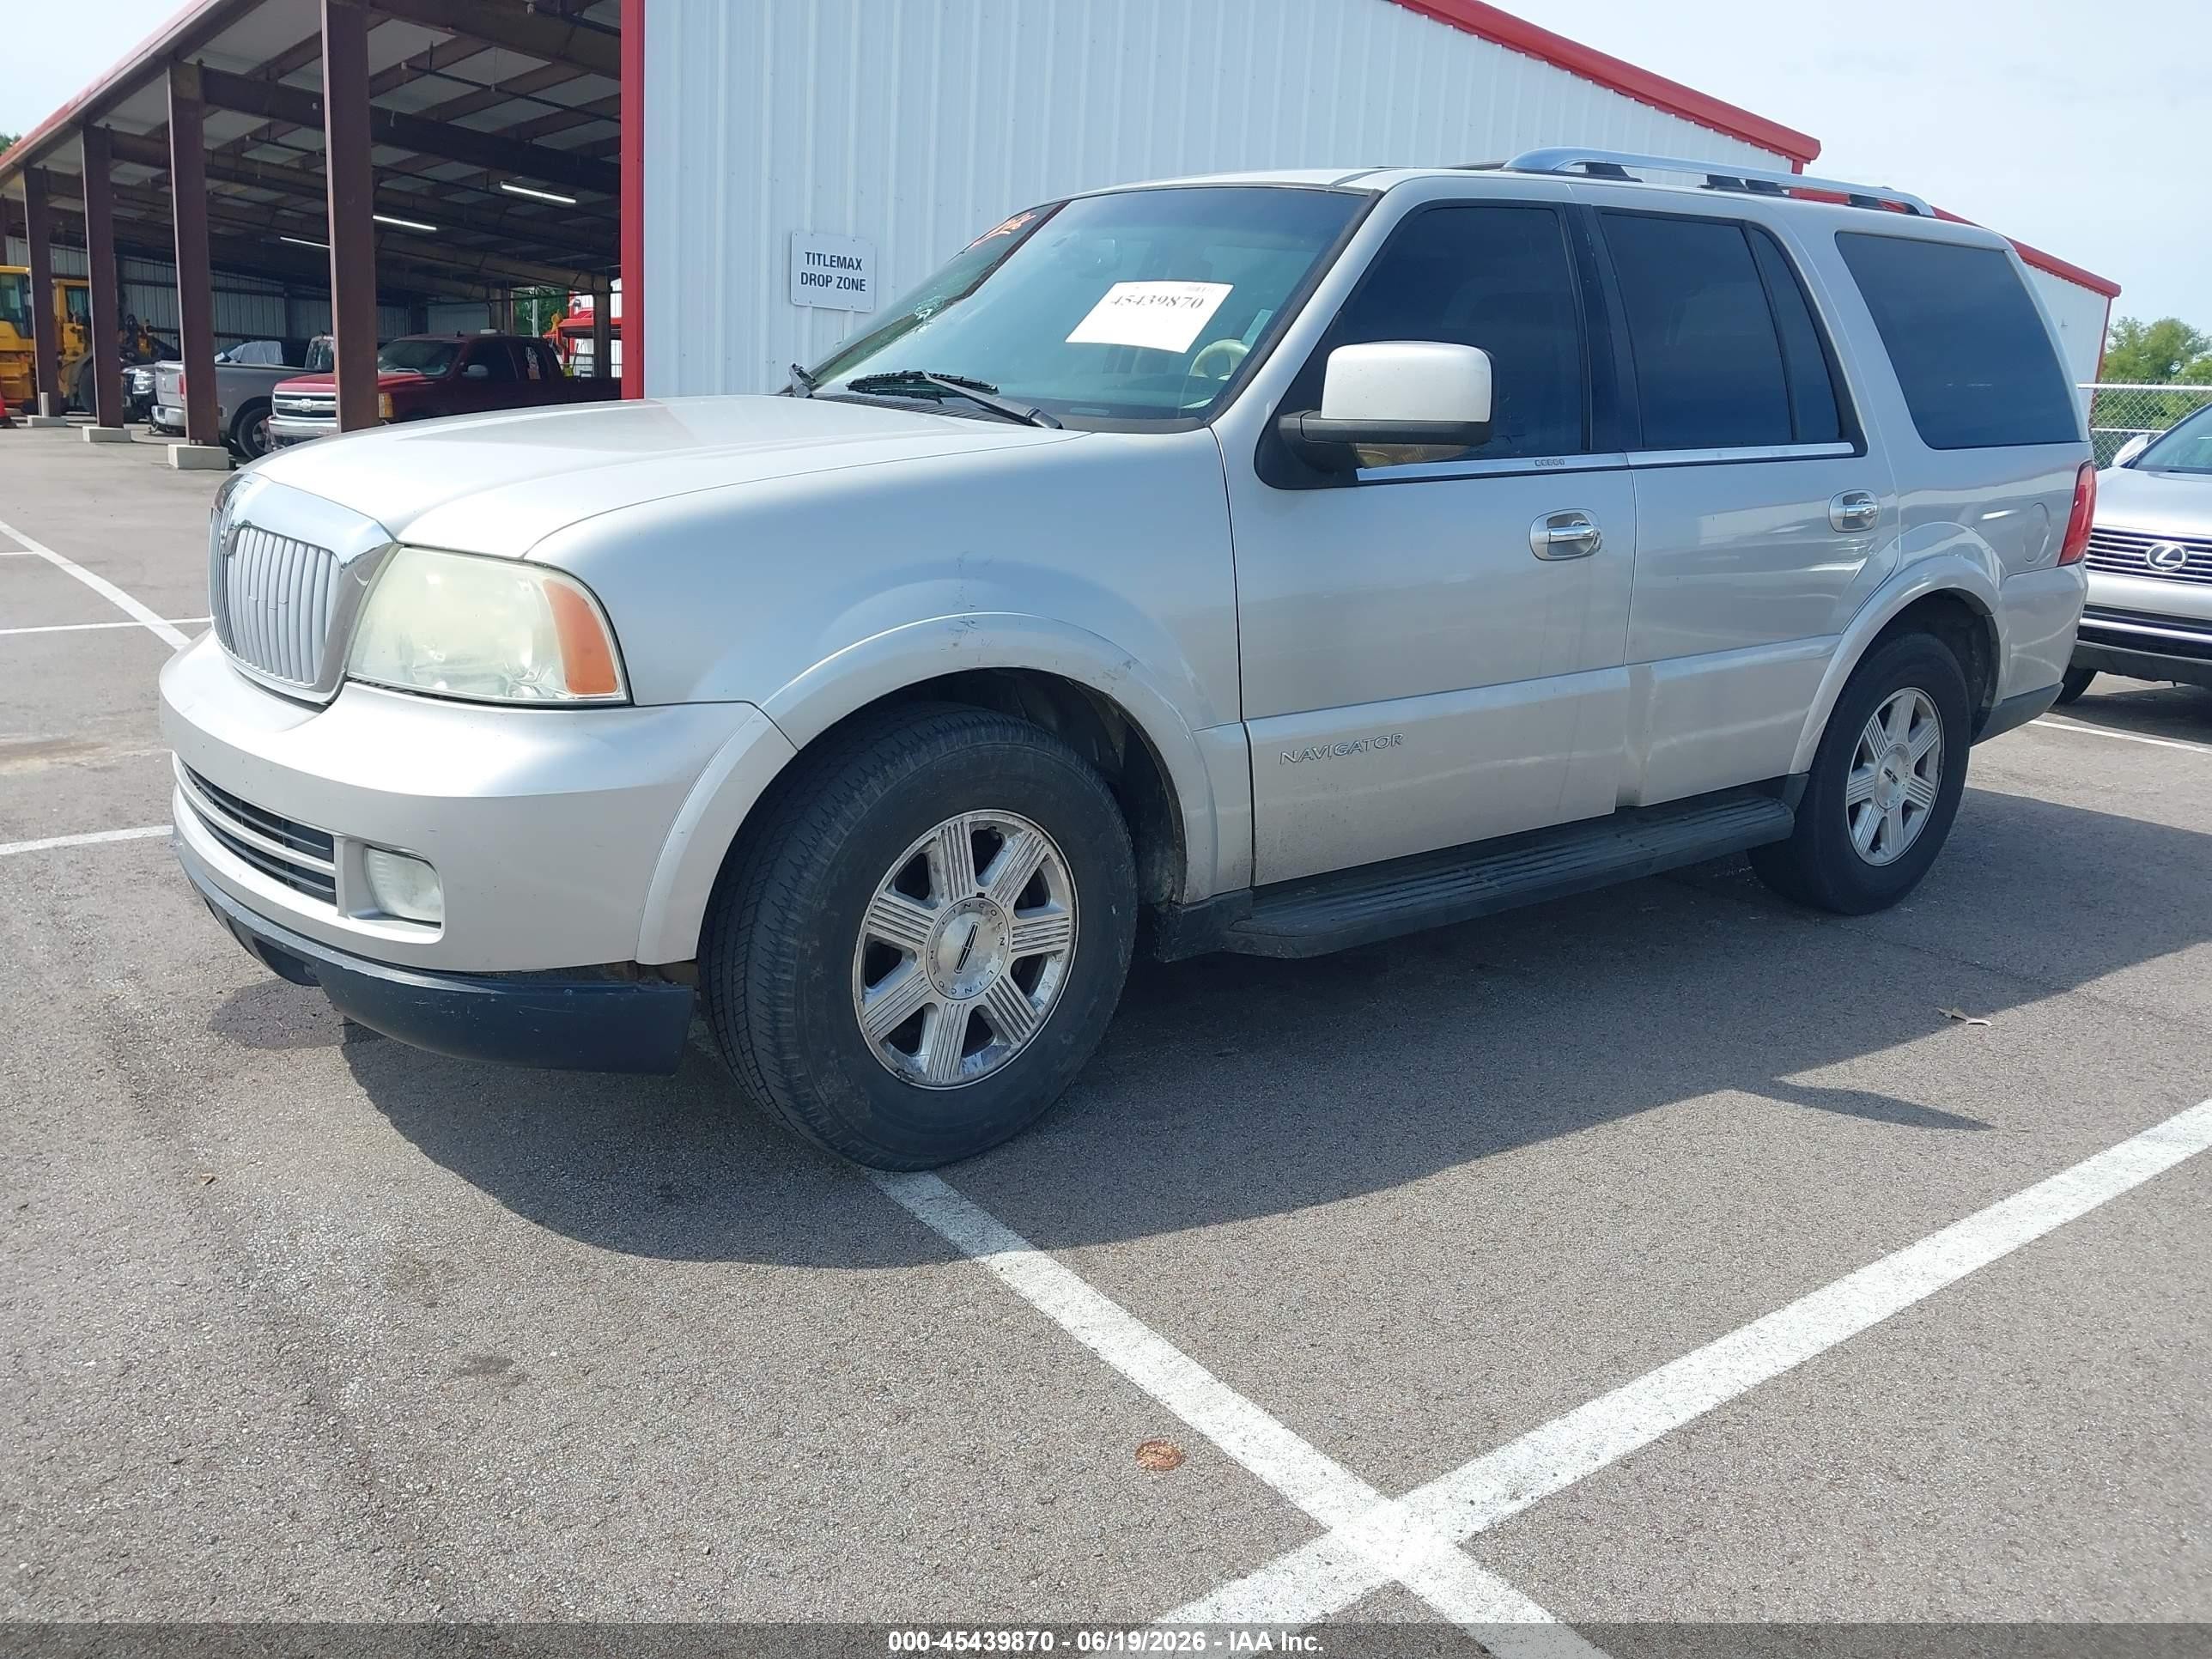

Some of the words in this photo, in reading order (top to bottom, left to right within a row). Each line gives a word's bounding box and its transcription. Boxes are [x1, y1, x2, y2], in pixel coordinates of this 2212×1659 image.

[805, 252, 862, 271] TITLEMAX
[800, 271, 833, 288] DROP
[836, 276, 866, 292] ZONE
[1110, 295, 1205, 309] 45439870
[1279, 732, 1404, 765] NAVIGATOR
[941, 902, 1006, 946] LINCOLN
[930, 950, 994, 994] LINCOLN
